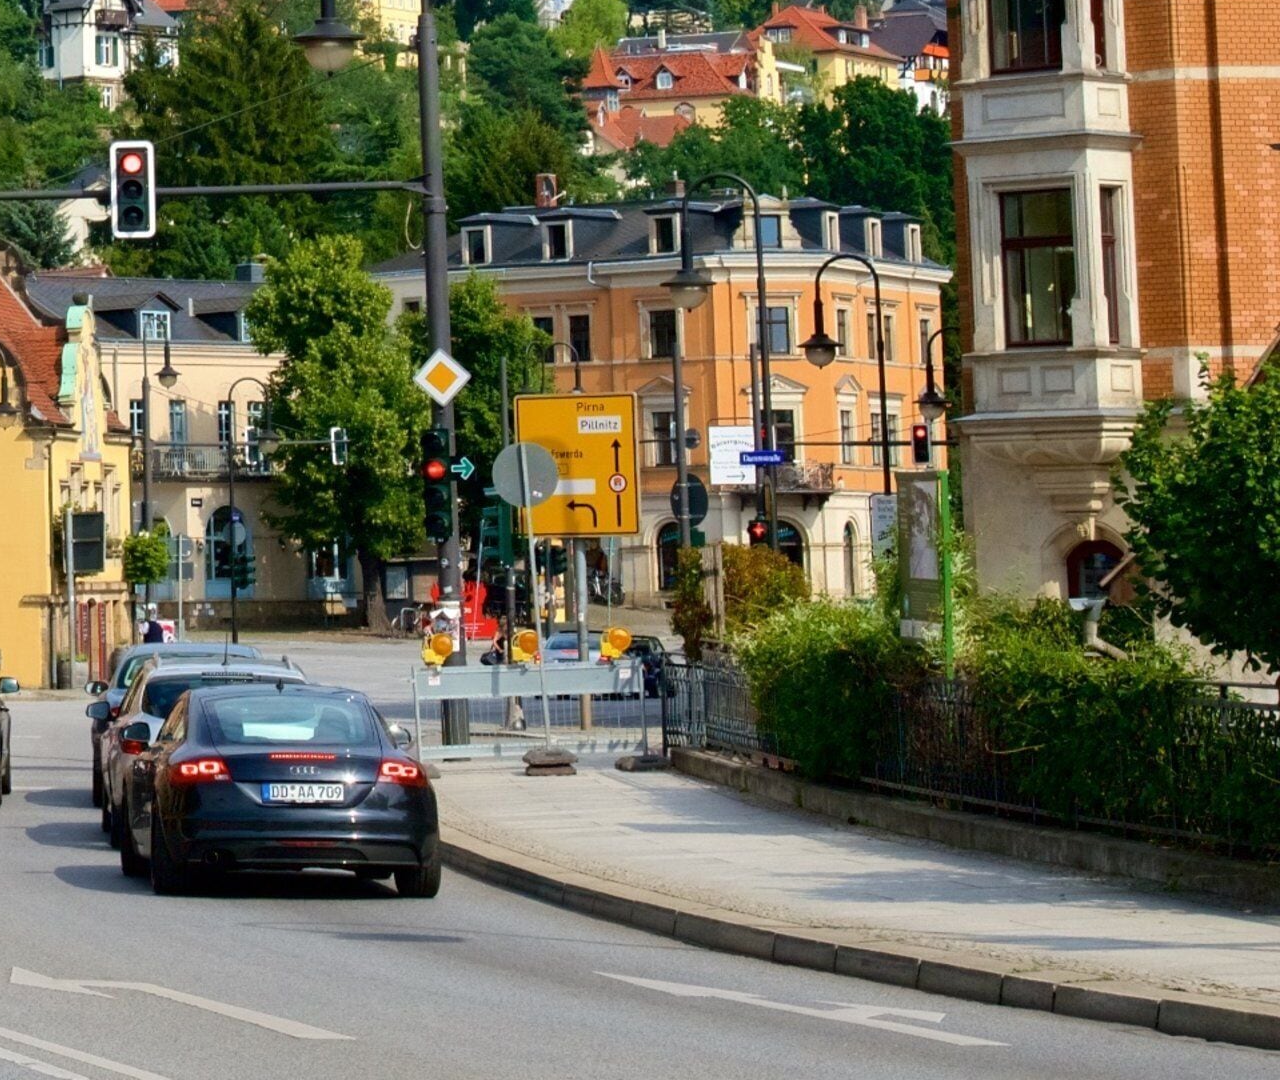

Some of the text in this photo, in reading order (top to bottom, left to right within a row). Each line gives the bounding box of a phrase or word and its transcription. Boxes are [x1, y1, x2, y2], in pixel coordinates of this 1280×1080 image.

[576, 402, 605, 412] Pirna
[580, 420, 619, 430] Pillnitz
[271, 785, 341, 799] DD AA 709
